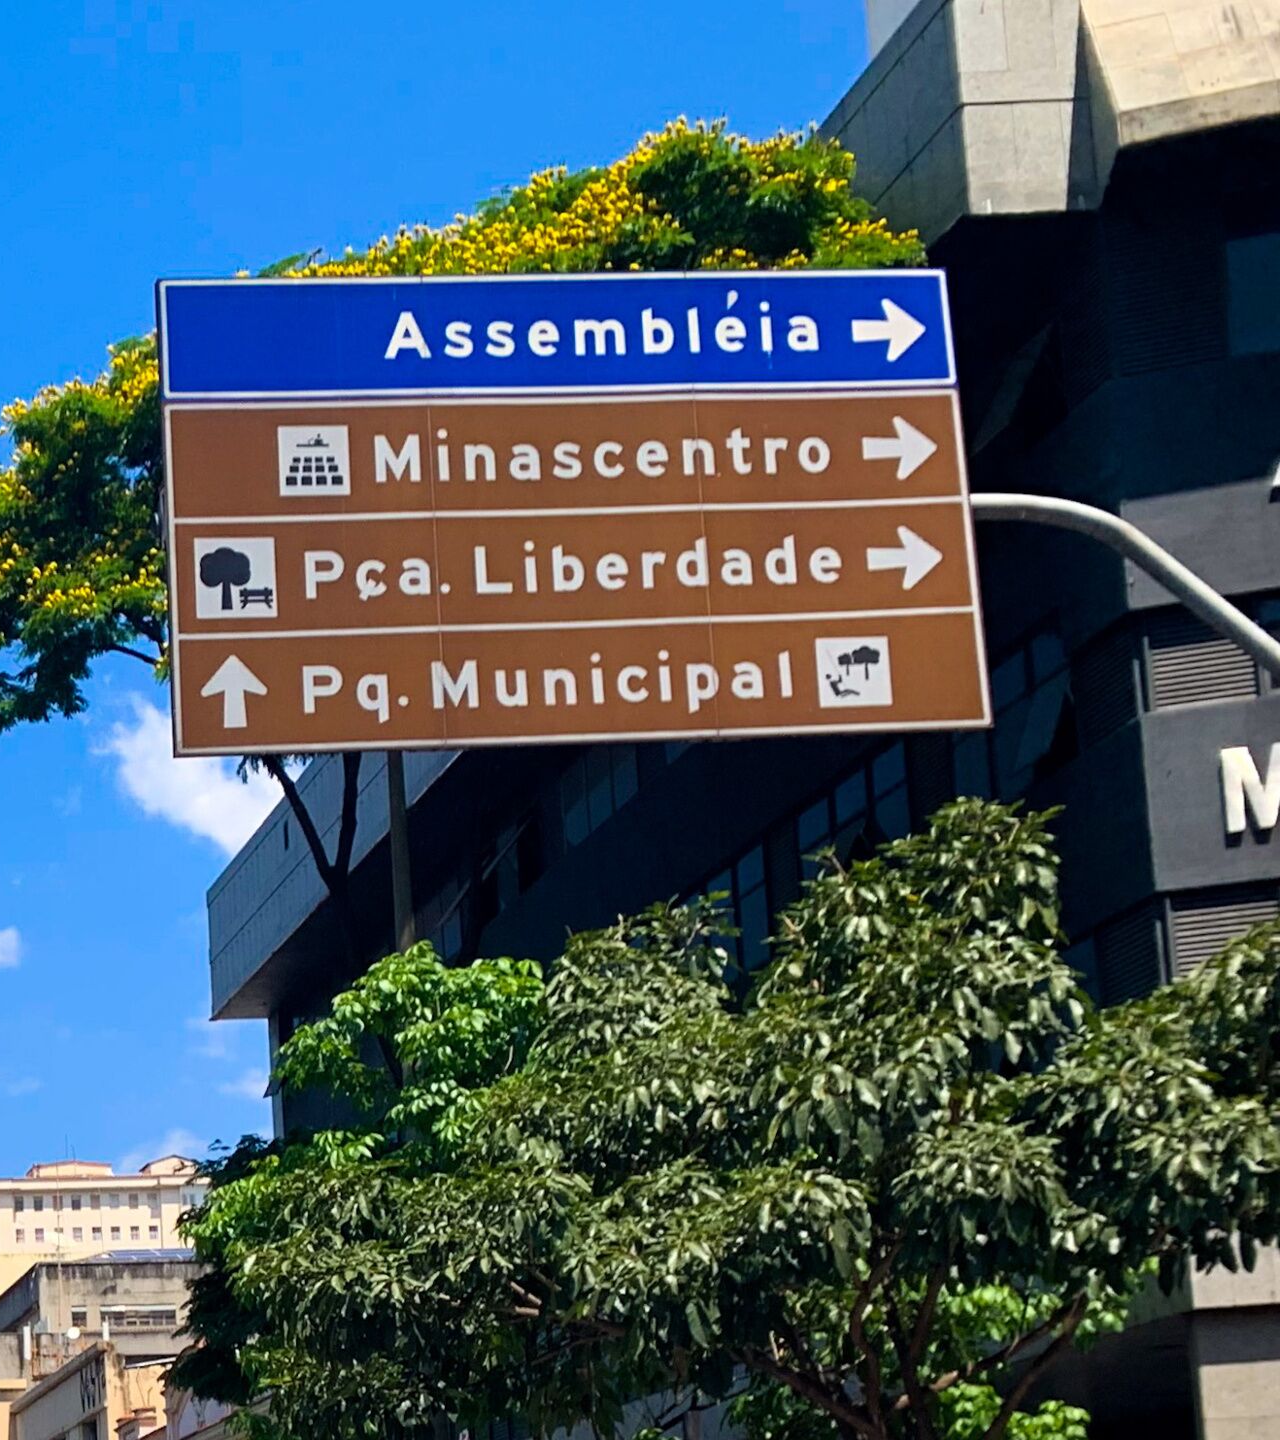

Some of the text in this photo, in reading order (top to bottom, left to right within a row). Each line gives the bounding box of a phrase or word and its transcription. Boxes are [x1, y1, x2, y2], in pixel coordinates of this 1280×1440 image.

[384, 290, 820, 360] Assembléia
[373, 427, 830, 483] Minascentro
[303, 535, 843, 601] Pça. Liberdade
[302, 650, 793, 723] Pq. Municipal
